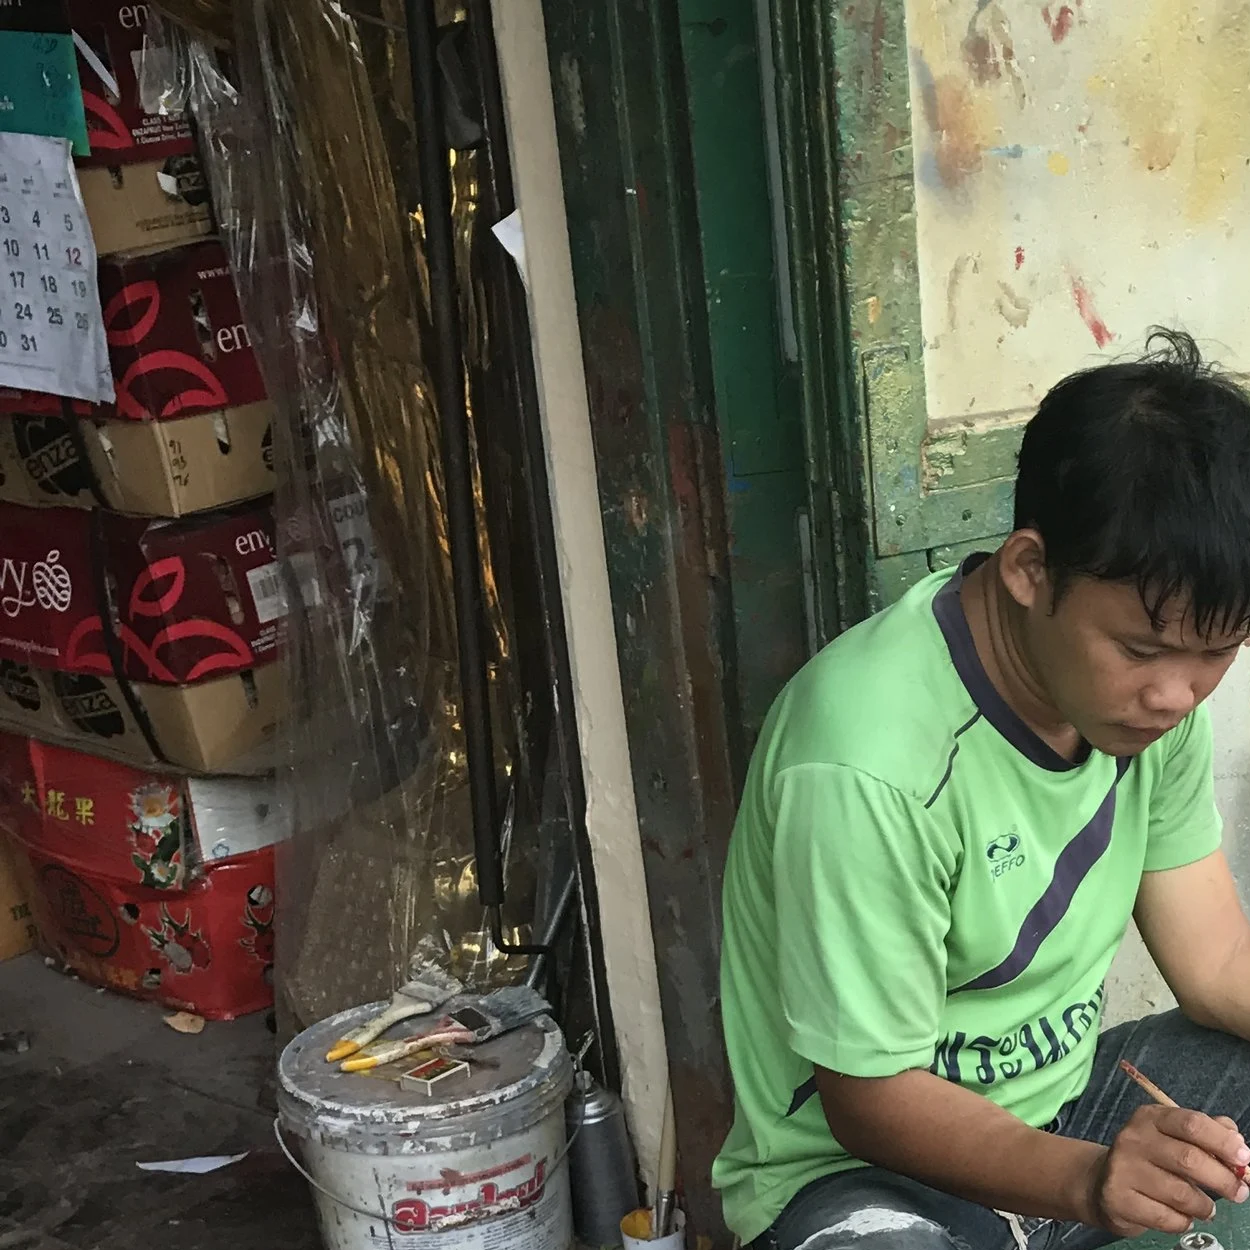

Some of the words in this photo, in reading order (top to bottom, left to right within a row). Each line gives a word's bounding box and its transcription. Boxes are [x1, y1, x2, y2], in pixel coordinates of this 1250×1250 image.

[0, 205, 10, 224] 3
[32, 210, 41, 228] 4
[63, 213, 74, 232] 5
[3, 238, 20, 257] 10
[33, 242, 50, 261] 11
[65, 247, 82, 266] 12
[10, 270, 26, 289] 17
[40, 275, 58, 294] 18
[71, 280, 87, 298] 19
[14, 302, 33, 321] 24
[46, 306, 64, 326] 25
[21, 333, 38, 352] 31
